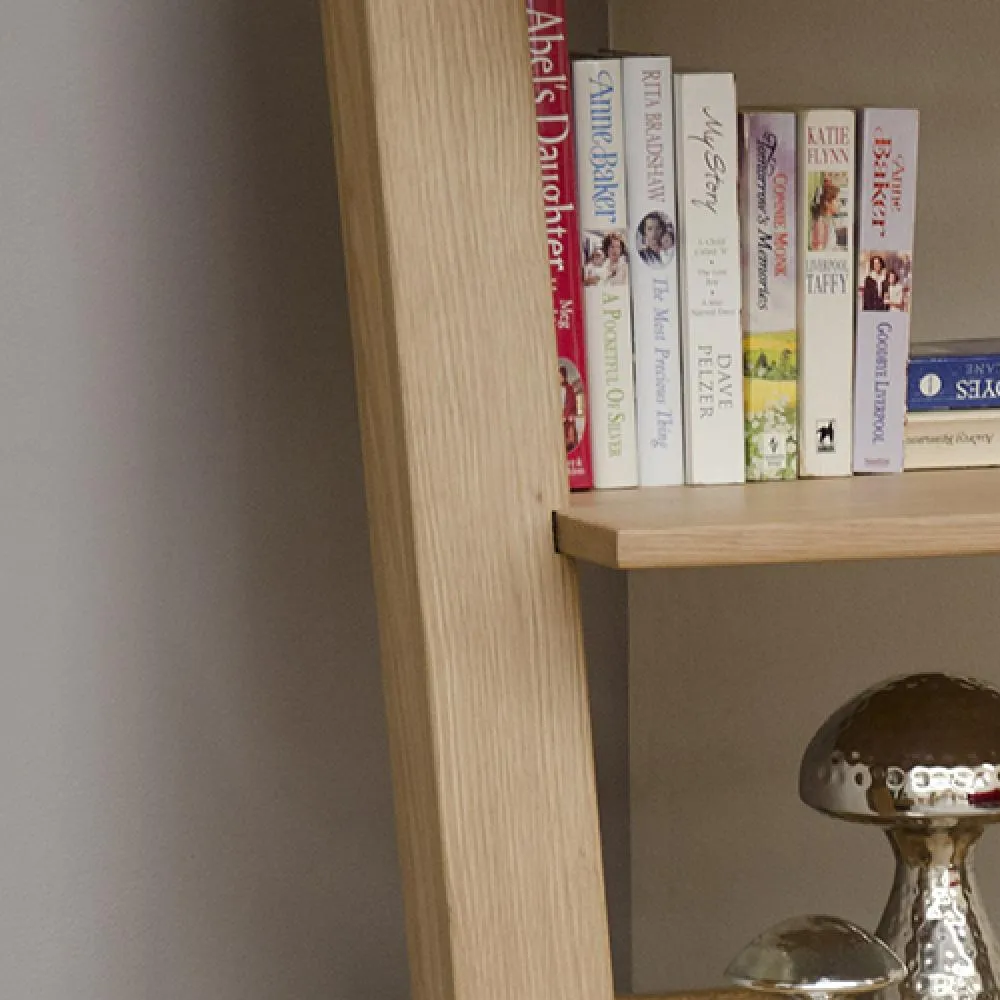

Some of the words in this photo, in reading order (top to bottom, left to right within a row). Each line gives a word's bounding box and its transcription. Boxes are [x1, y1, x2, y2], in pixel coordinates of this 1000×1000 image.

[526, 8, 568, 104] Abel's
[589, 70, 616, 145] Anne
[641, 69, 662, 108] RITA
[643, 111, 666, 202] BRADSHAW
[808, 126, 849, 145] KATIE
[808, 147, 849, 164] FLYNN
[589, 146, 619, 224] Baker
[872, 127, 893, 238] Baker
[891, 155, 905, 211] Anne
[653, 278, 670, 302] The
[756, 228, 772, 310] Memories
[807, 273, 847, 294] TAFFY
[602, 293, 620, 304] A
[654, 307, 671, 341] Most
[654, 347, 672, 405] Precious
[697, 345, 714, 419] PELZER
[717, 353, 733, 409] DAVE
[651, 410, 674, 448] Thing
